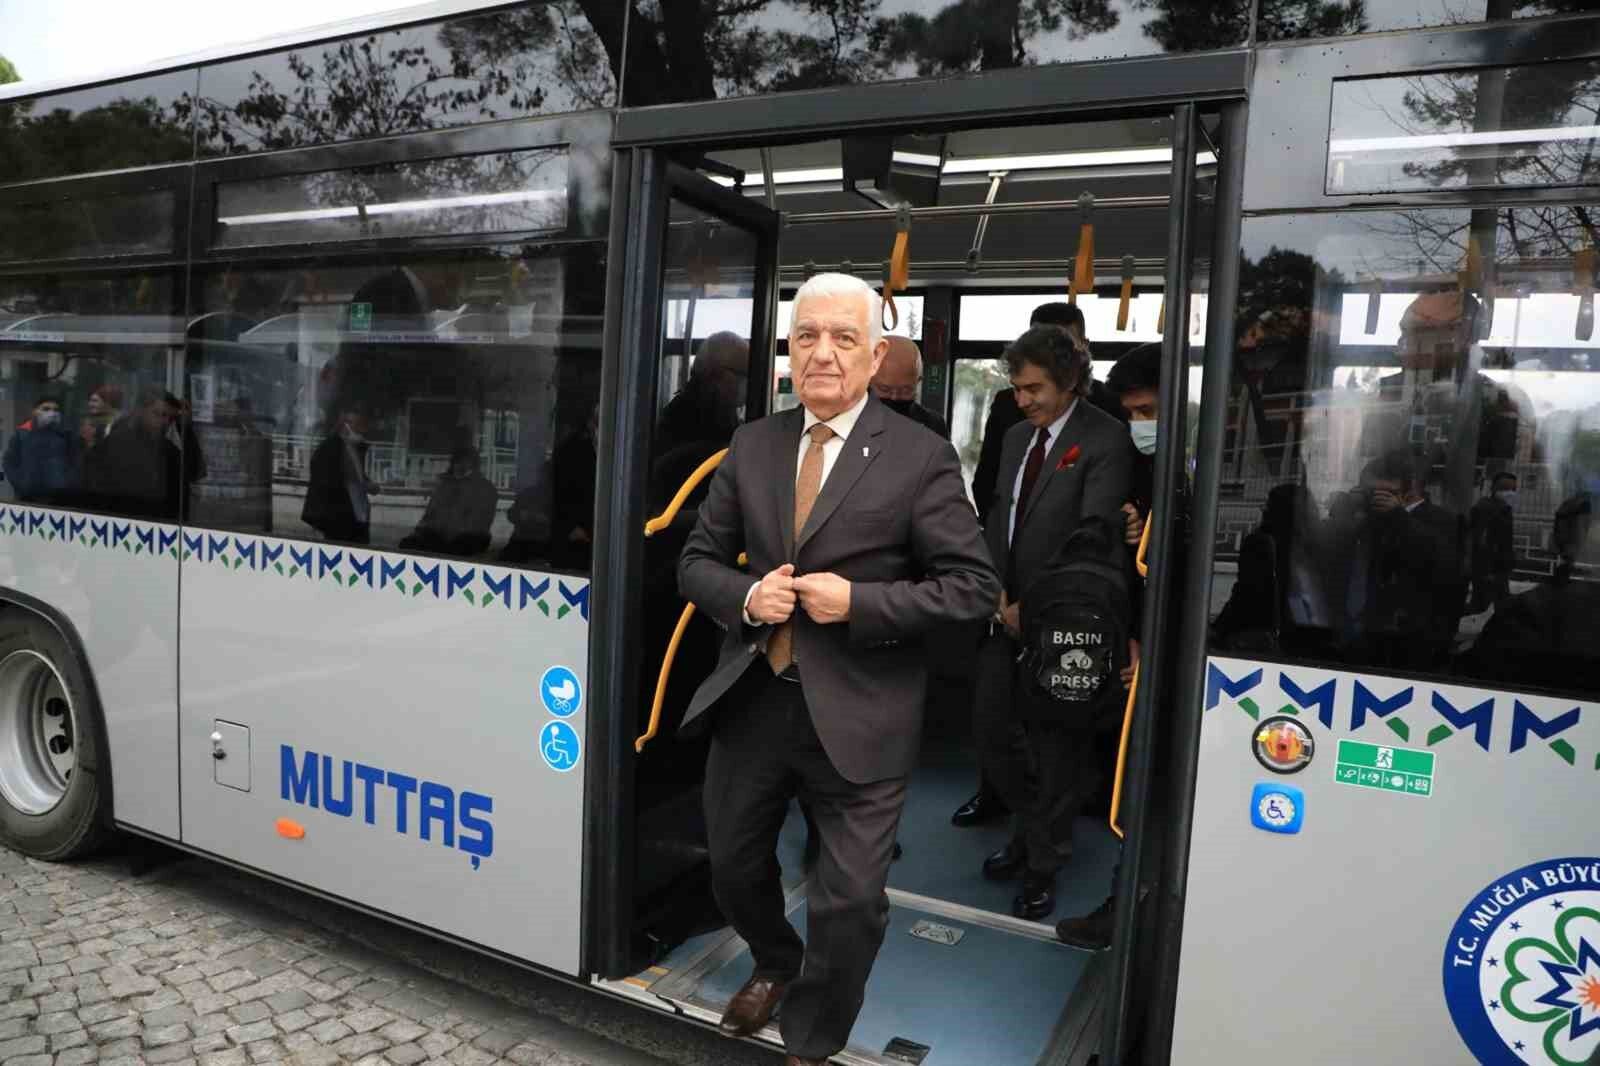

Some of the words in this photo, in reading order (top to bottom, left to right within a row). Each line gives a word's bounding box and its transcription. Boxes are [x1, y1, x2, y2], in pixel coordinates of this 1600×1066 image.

[1053, 631, 1101, 645] BASIN
[1051, 674, 1100, 689] PRESS
[280, 744, 493, 871] MUTTAŞ
[1453, 936, 1480, 967] T.C.
[1469, 876, 1540, 931] MUĞLA
